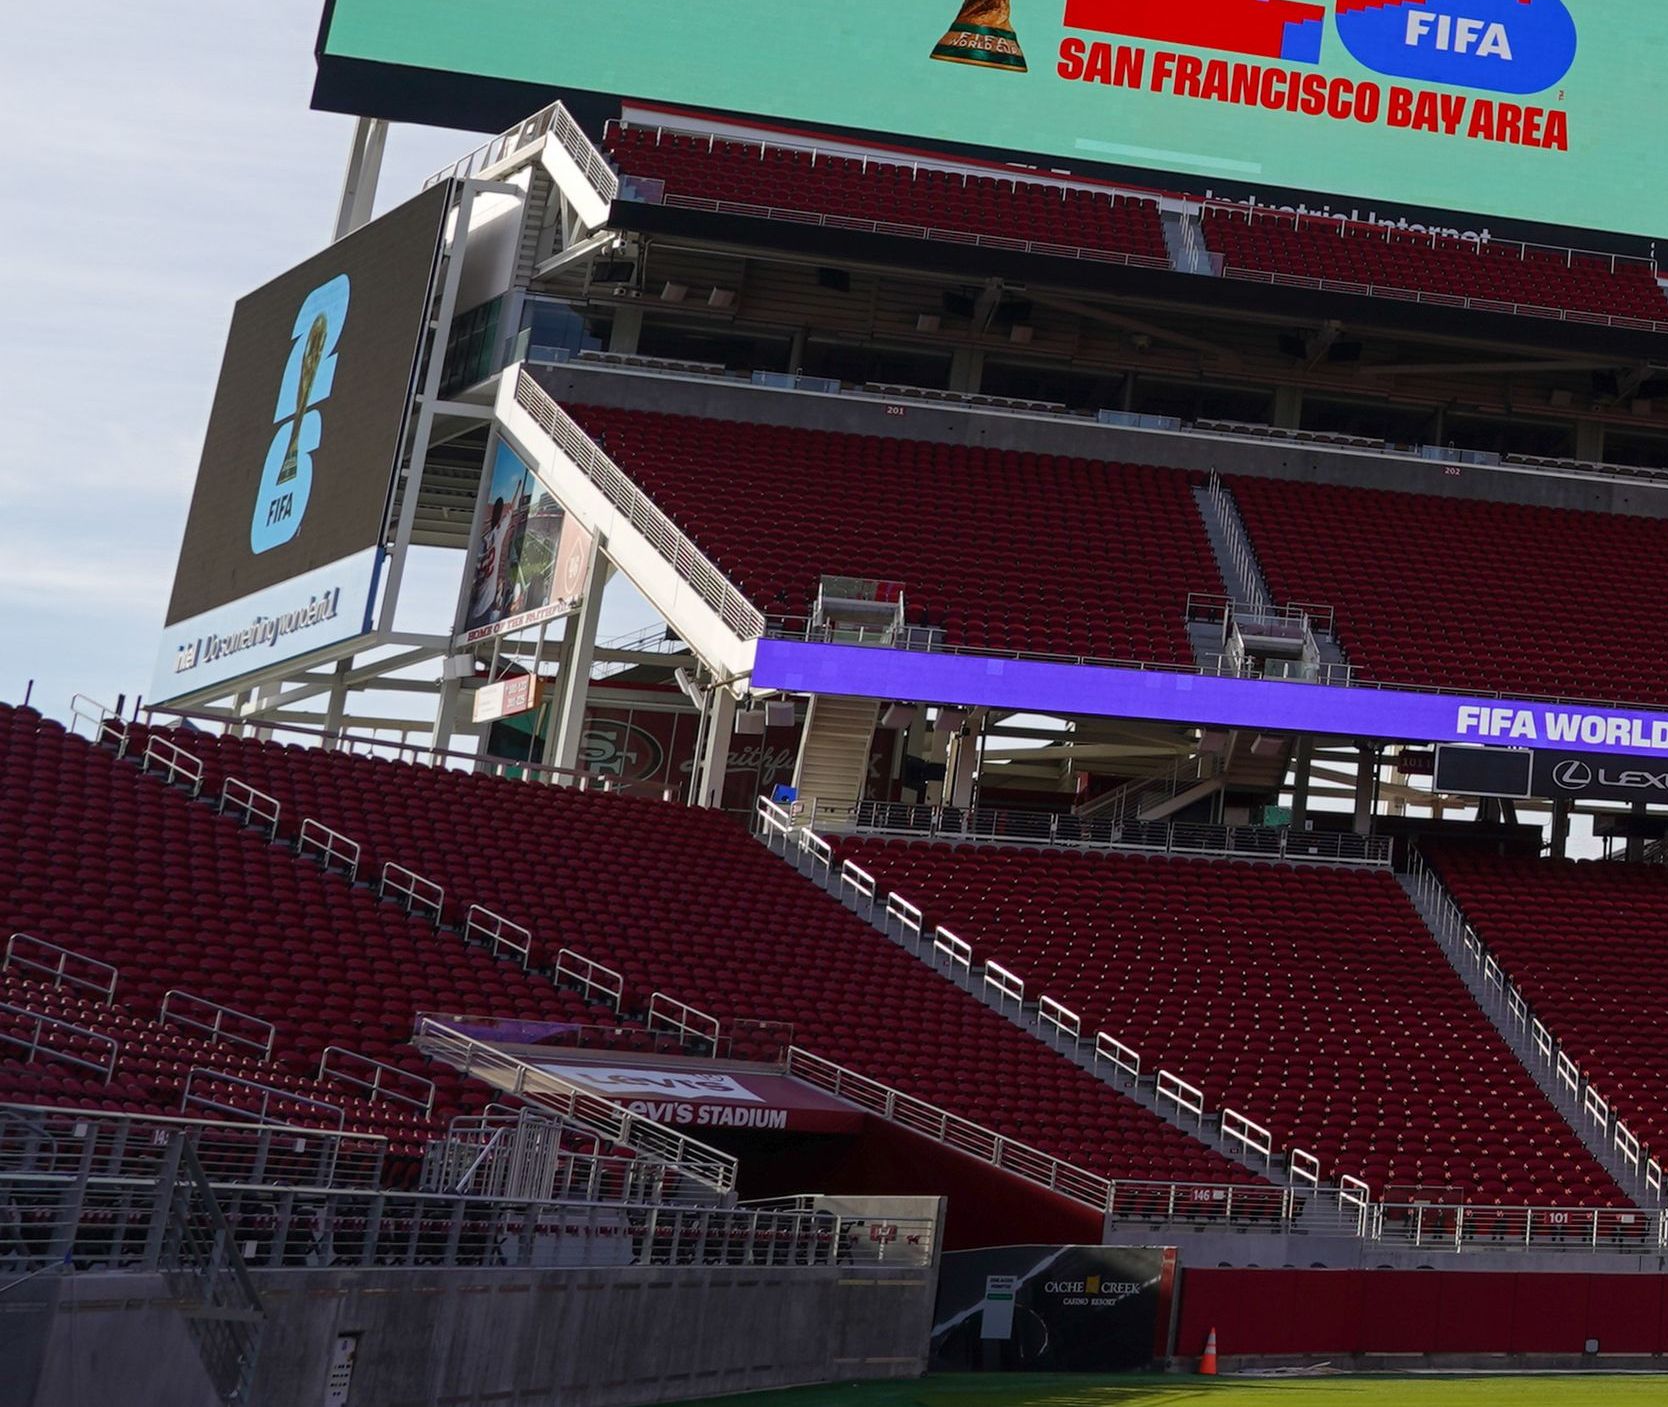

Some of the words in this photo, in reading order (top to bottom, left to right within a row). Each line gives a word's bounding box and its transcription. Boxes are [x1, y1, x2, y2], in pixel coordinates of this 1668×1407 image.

[1404, 9, 1514, 61] FIFA
[1056, 37, 1145, 89] SAN
[1151, 51, 1380, 121] FRANCISCO
[1387, 86, 1465, 135] BAY
[1467, 96, 1569, 151] AREA
[887, 407, 904, 415] 201
[1445, 467, 1461, 476] 202
[266, 492, 293, 527] FIFA
[467, 625, 493, 641] HOME
[1457, 705, 1537, 740] FIFA
[697, 1104, 788, 1129] STADIUM
[1194, 1190, 1210, 1201] 146
[1549, 1212, 1569, 1223] 101
[1044, 1281, 1084, 1294] CACHE
[1100, 1282, 1140, 1295] CREEK
